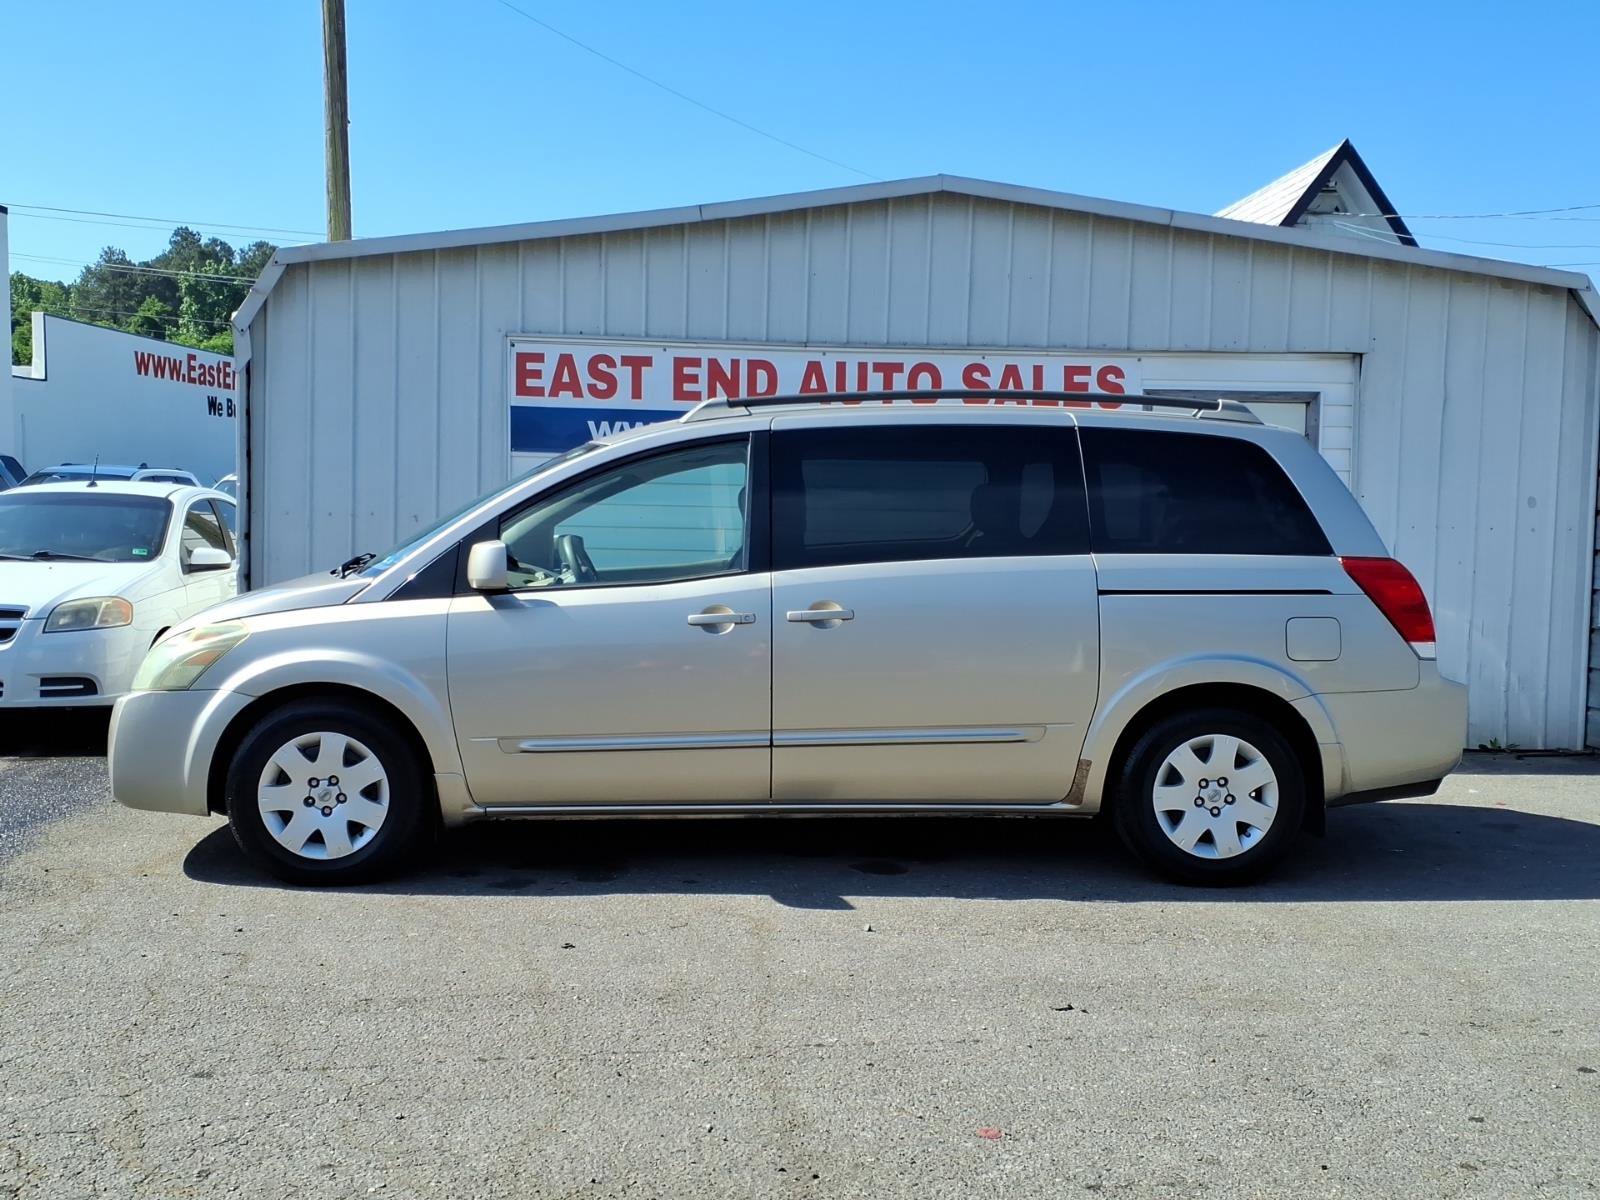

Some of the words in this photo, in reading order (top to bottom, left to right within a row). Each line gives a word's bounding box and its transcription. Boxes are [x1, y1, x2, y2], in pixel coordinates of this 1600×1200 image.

[134, 350, 236, 391] www.EastE
[515, 351, 653, 401] EAST
[672, 356, 779, 401] END
[798, 360, 943, 406] AUTO
[960, 362, 1126, 410] SALES
[207, 395, 223, 418] We
[226, 397, 236, 418] B
